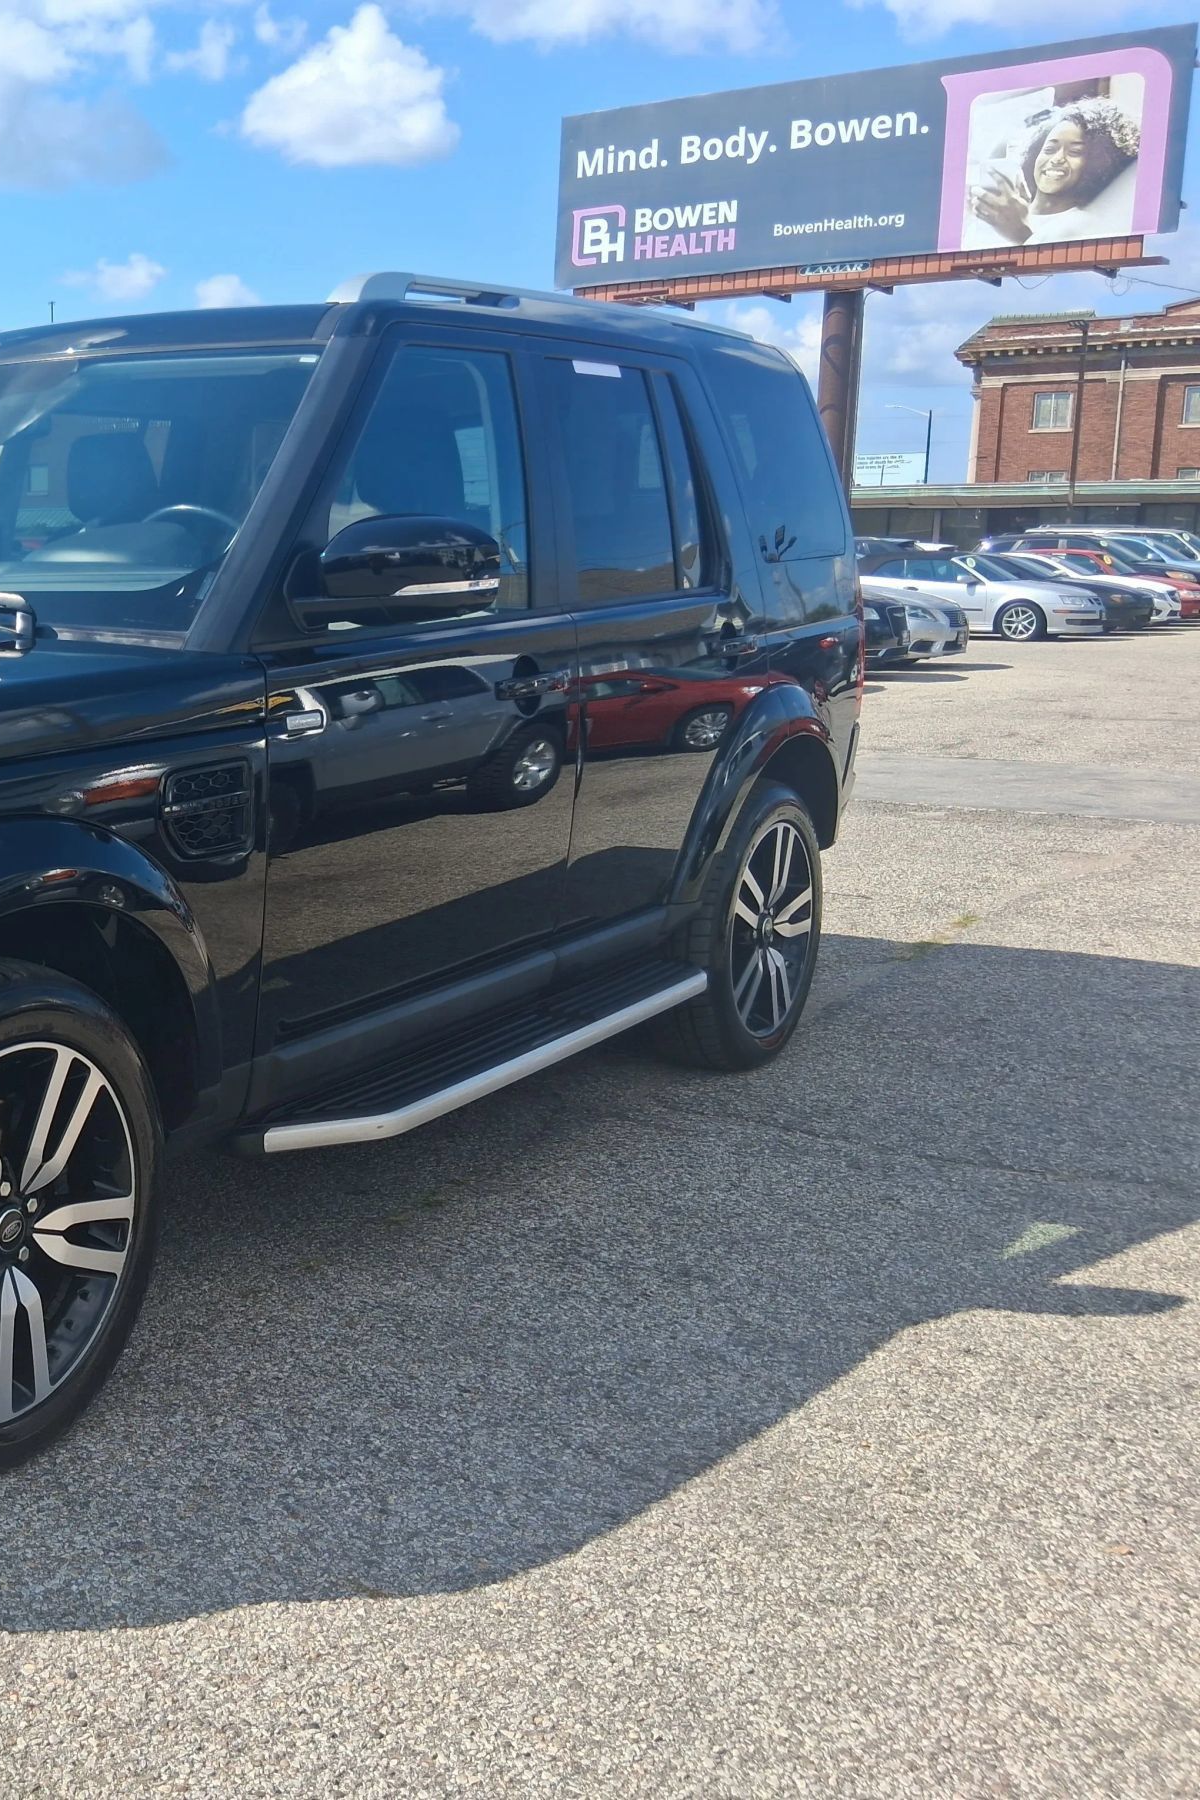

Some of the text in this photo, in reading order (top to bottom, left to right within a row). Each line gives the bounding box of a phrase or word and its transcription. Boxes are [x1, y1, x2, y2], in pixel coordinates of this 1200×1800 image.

[576, 111, 930, 179] Mind. Body. Bowen.
[634, 200, 738, 233] BOWEN
[773, 212, 906, 237] BowenHealth.org
[583, 218, 625, 263] BH
[634, 228, 737, 260] HEALTH
[804, 262, 864, 275] LAMAR
